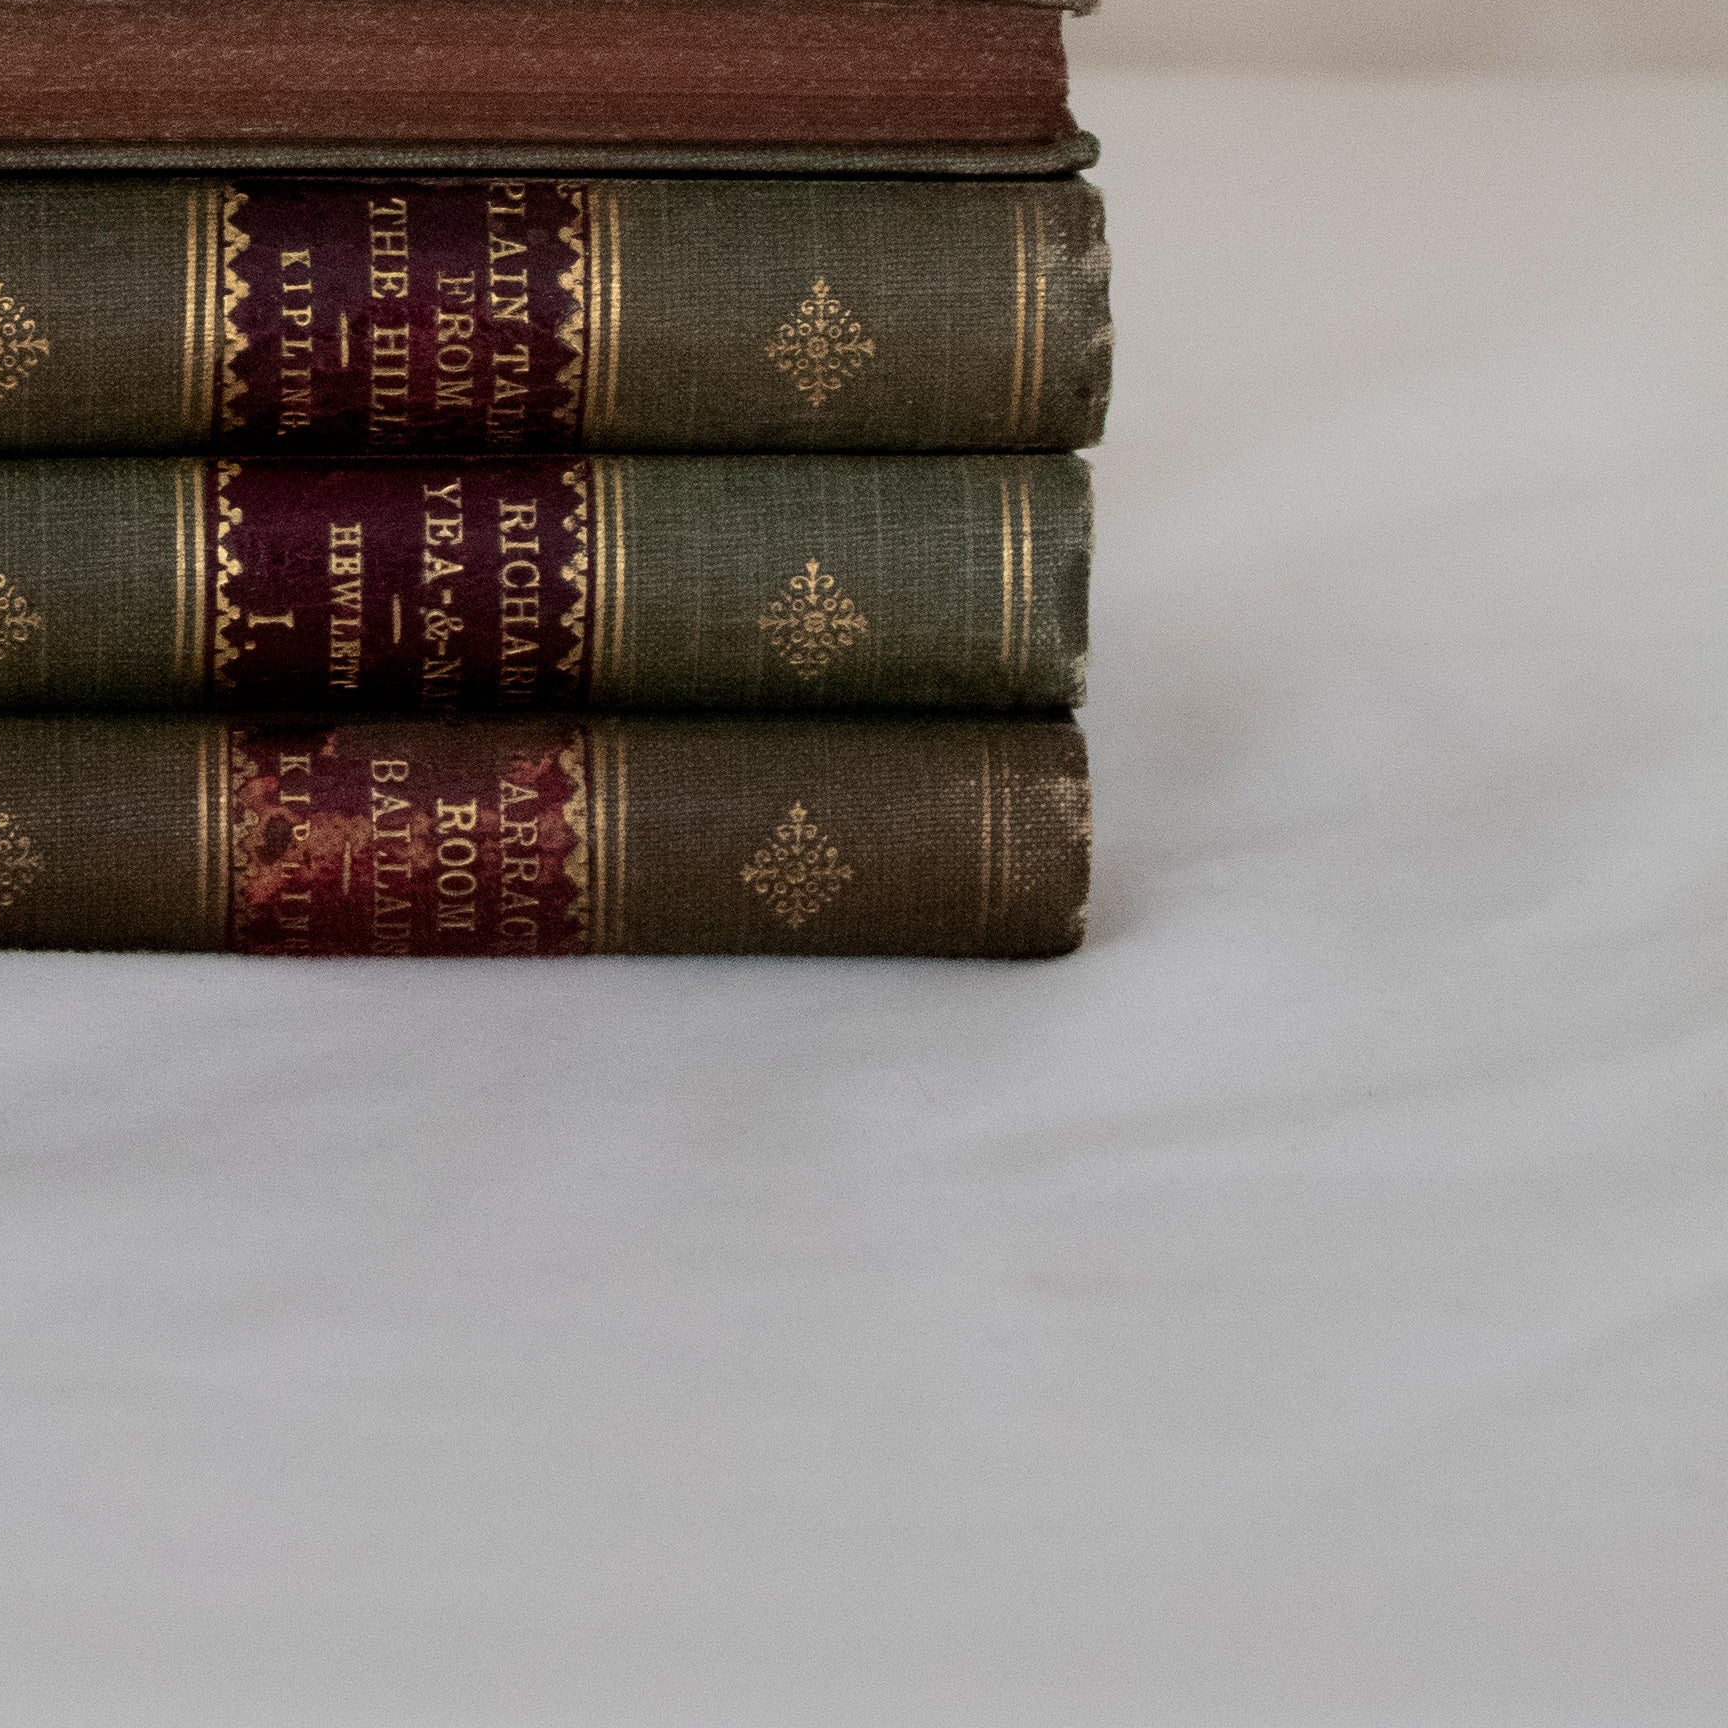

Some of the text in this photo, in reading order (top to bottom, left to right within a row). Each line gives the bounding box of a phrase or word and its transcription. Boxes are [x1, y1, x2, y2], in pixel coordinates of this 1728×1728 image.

[369, 197, 410, 300] THE
[435, 270, 475, 411] FROM
[436, 797, 477, 933] ROOM
